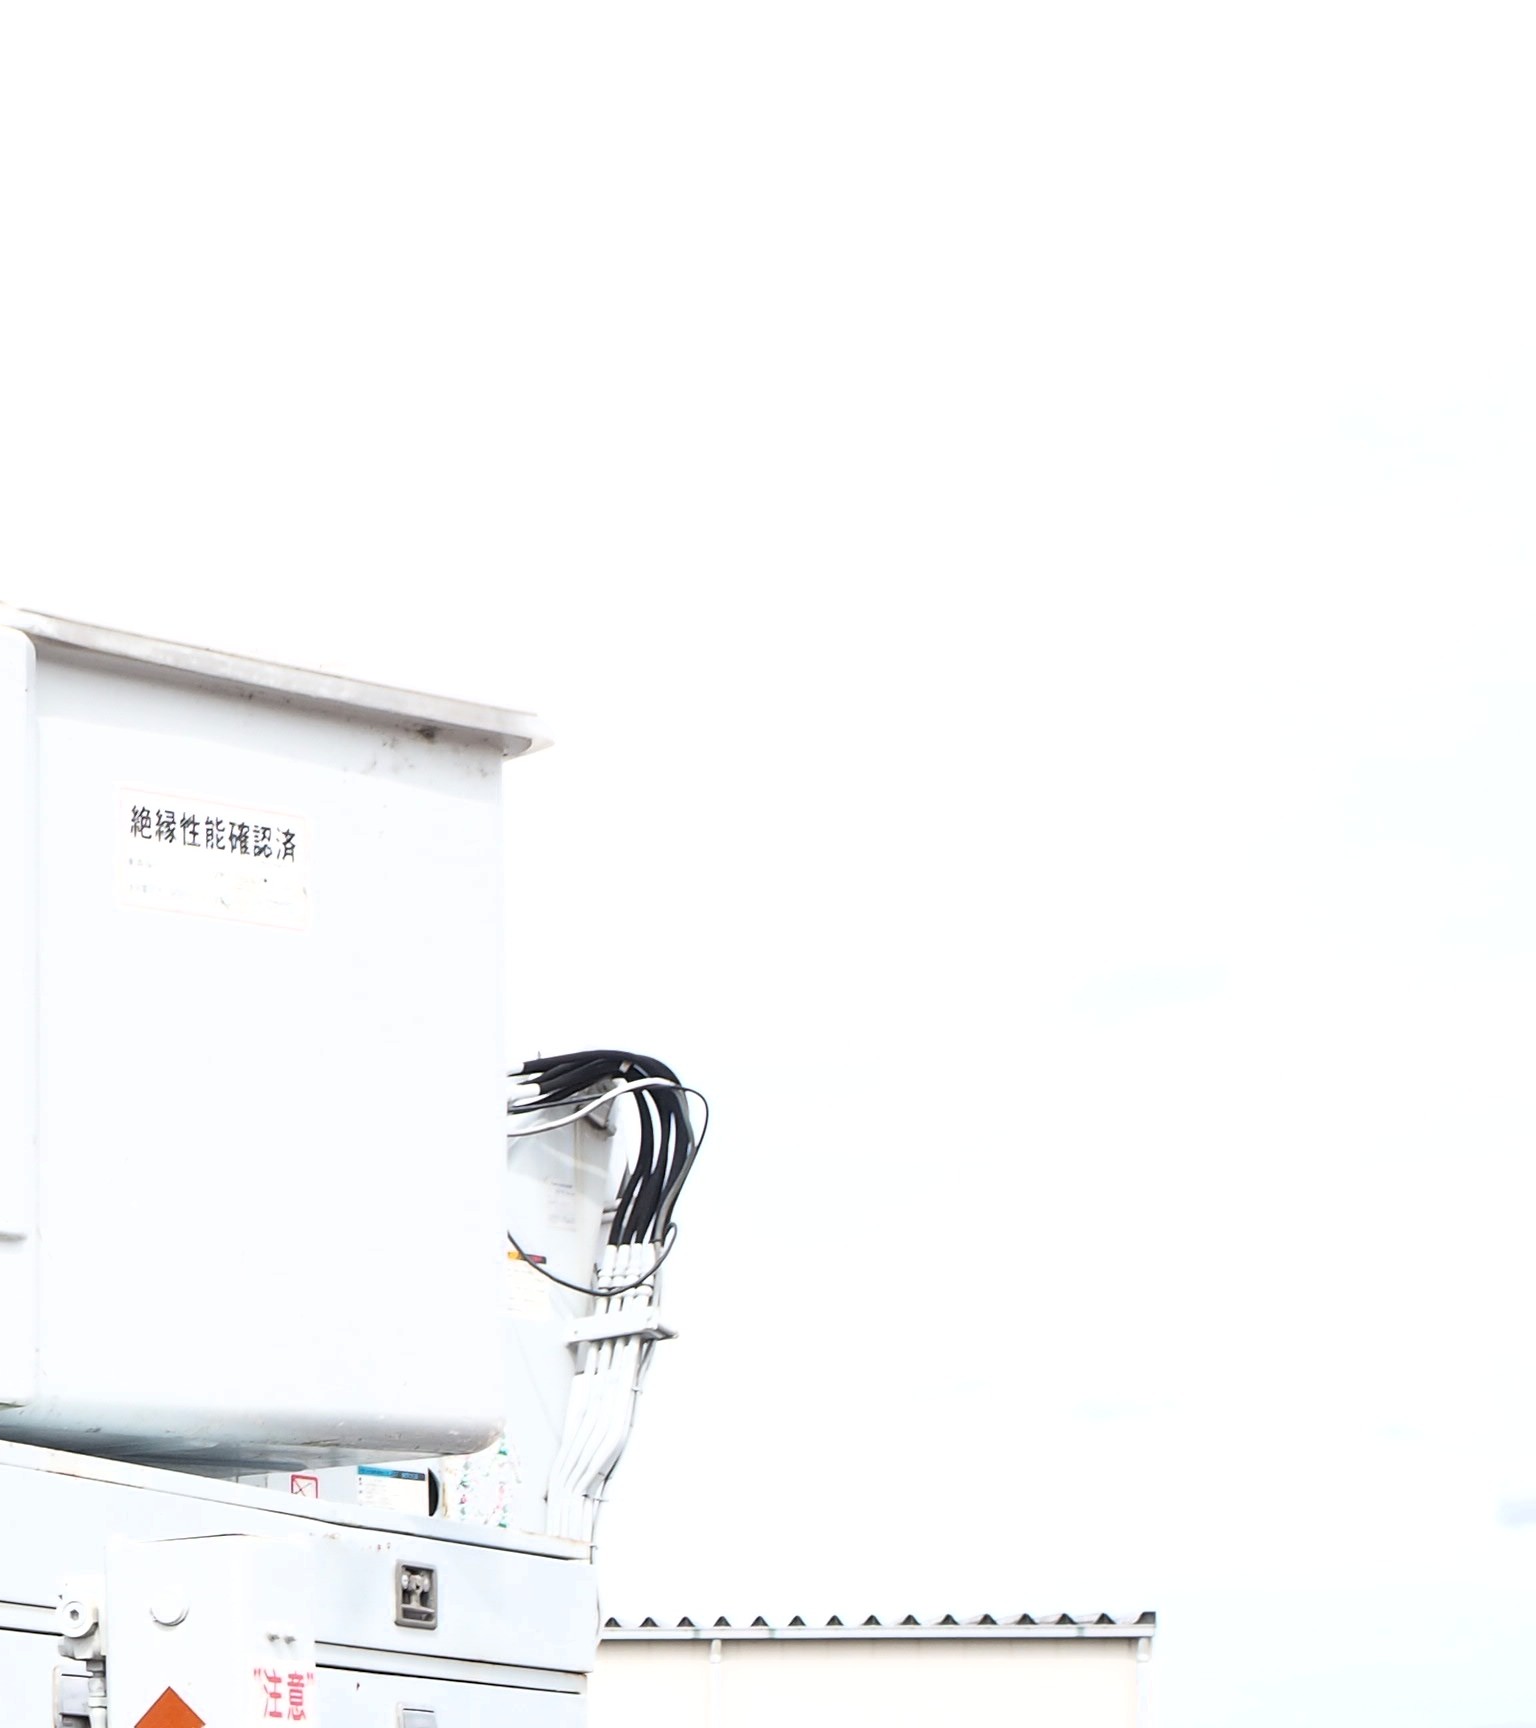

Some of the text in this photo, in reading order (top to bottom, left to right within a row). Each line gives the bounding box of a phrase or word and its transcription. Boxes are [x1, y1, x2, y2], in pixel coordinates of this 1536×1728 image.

[130, 804, 296, 863] 絶縁性能確認済
